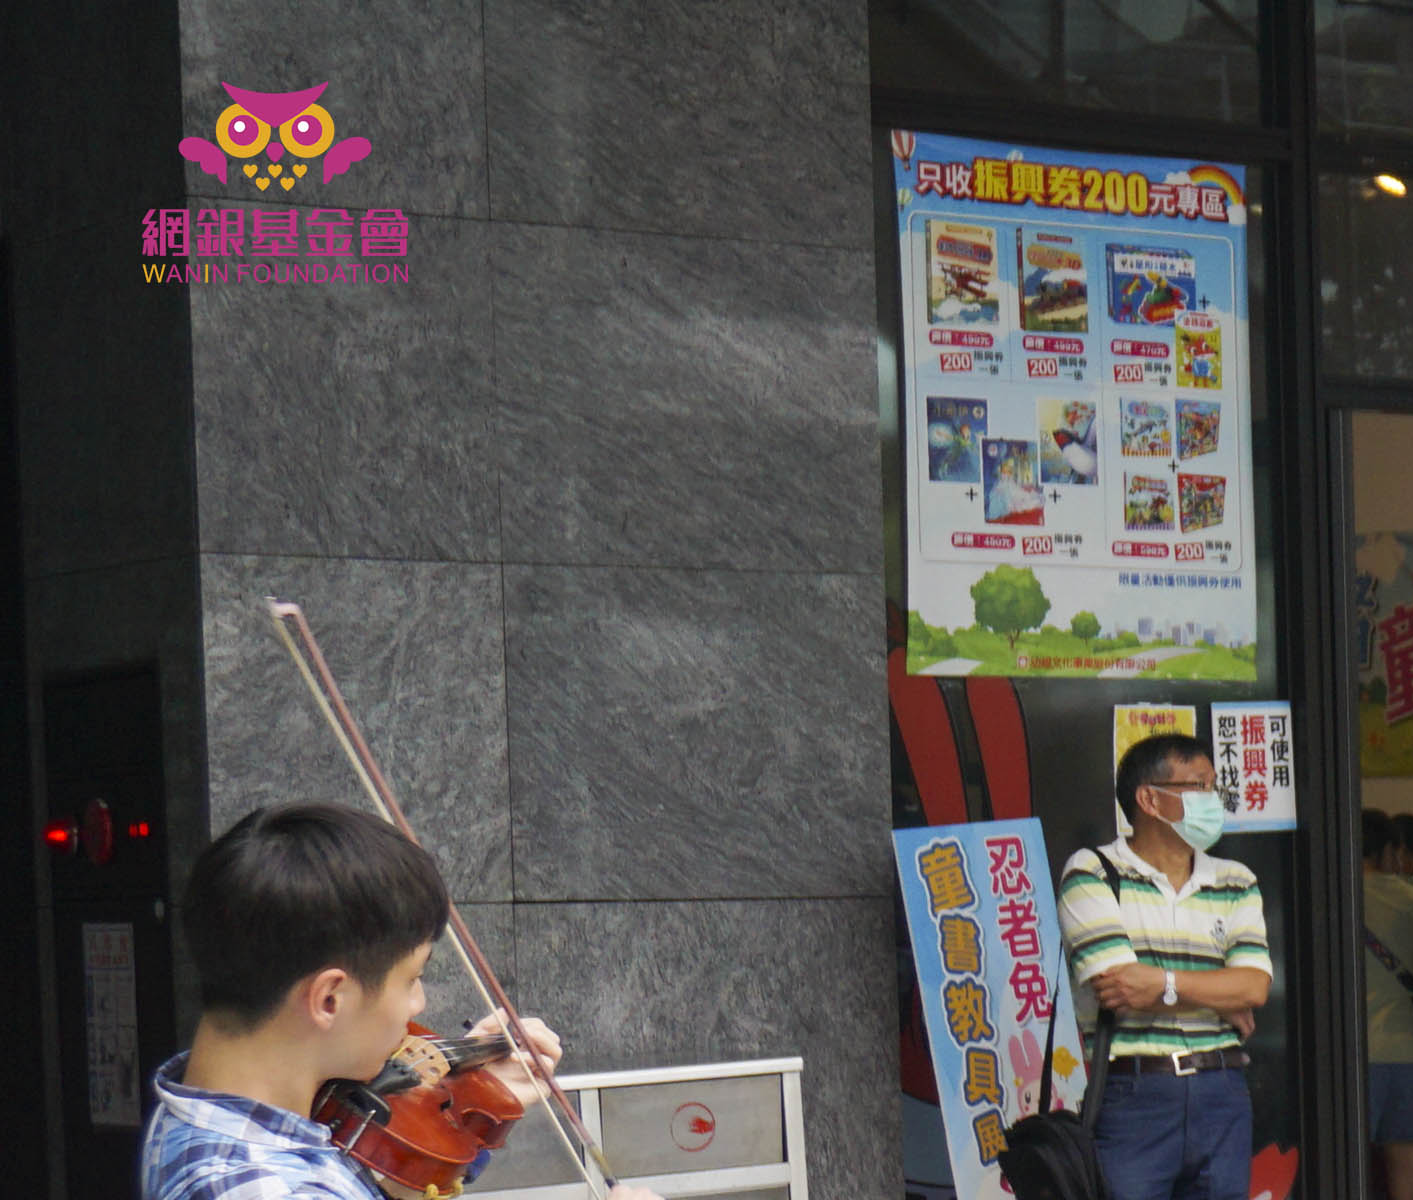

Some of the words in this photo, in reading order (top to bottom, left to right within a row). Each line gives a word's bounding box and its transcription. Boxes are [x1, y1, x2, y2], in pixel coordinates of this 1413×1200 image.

[917, 157, 1229, 221] 只收振興券200元專區
[944, 354, 971, 370] 200
[1030, 360, 1056, 375] 200
[1117, 366, 1142, 381] 200
[1025, 538, 1051, 554] 200
[1177, 545, 1202, 559] 200
[1240, 714, 1268, 812] 振興券
[1269, 715, 1290, 787] 可使用
[985, 837, 1053, 1022] 忍者兔
[918, 841, 1009, 1166] 童書教具展
